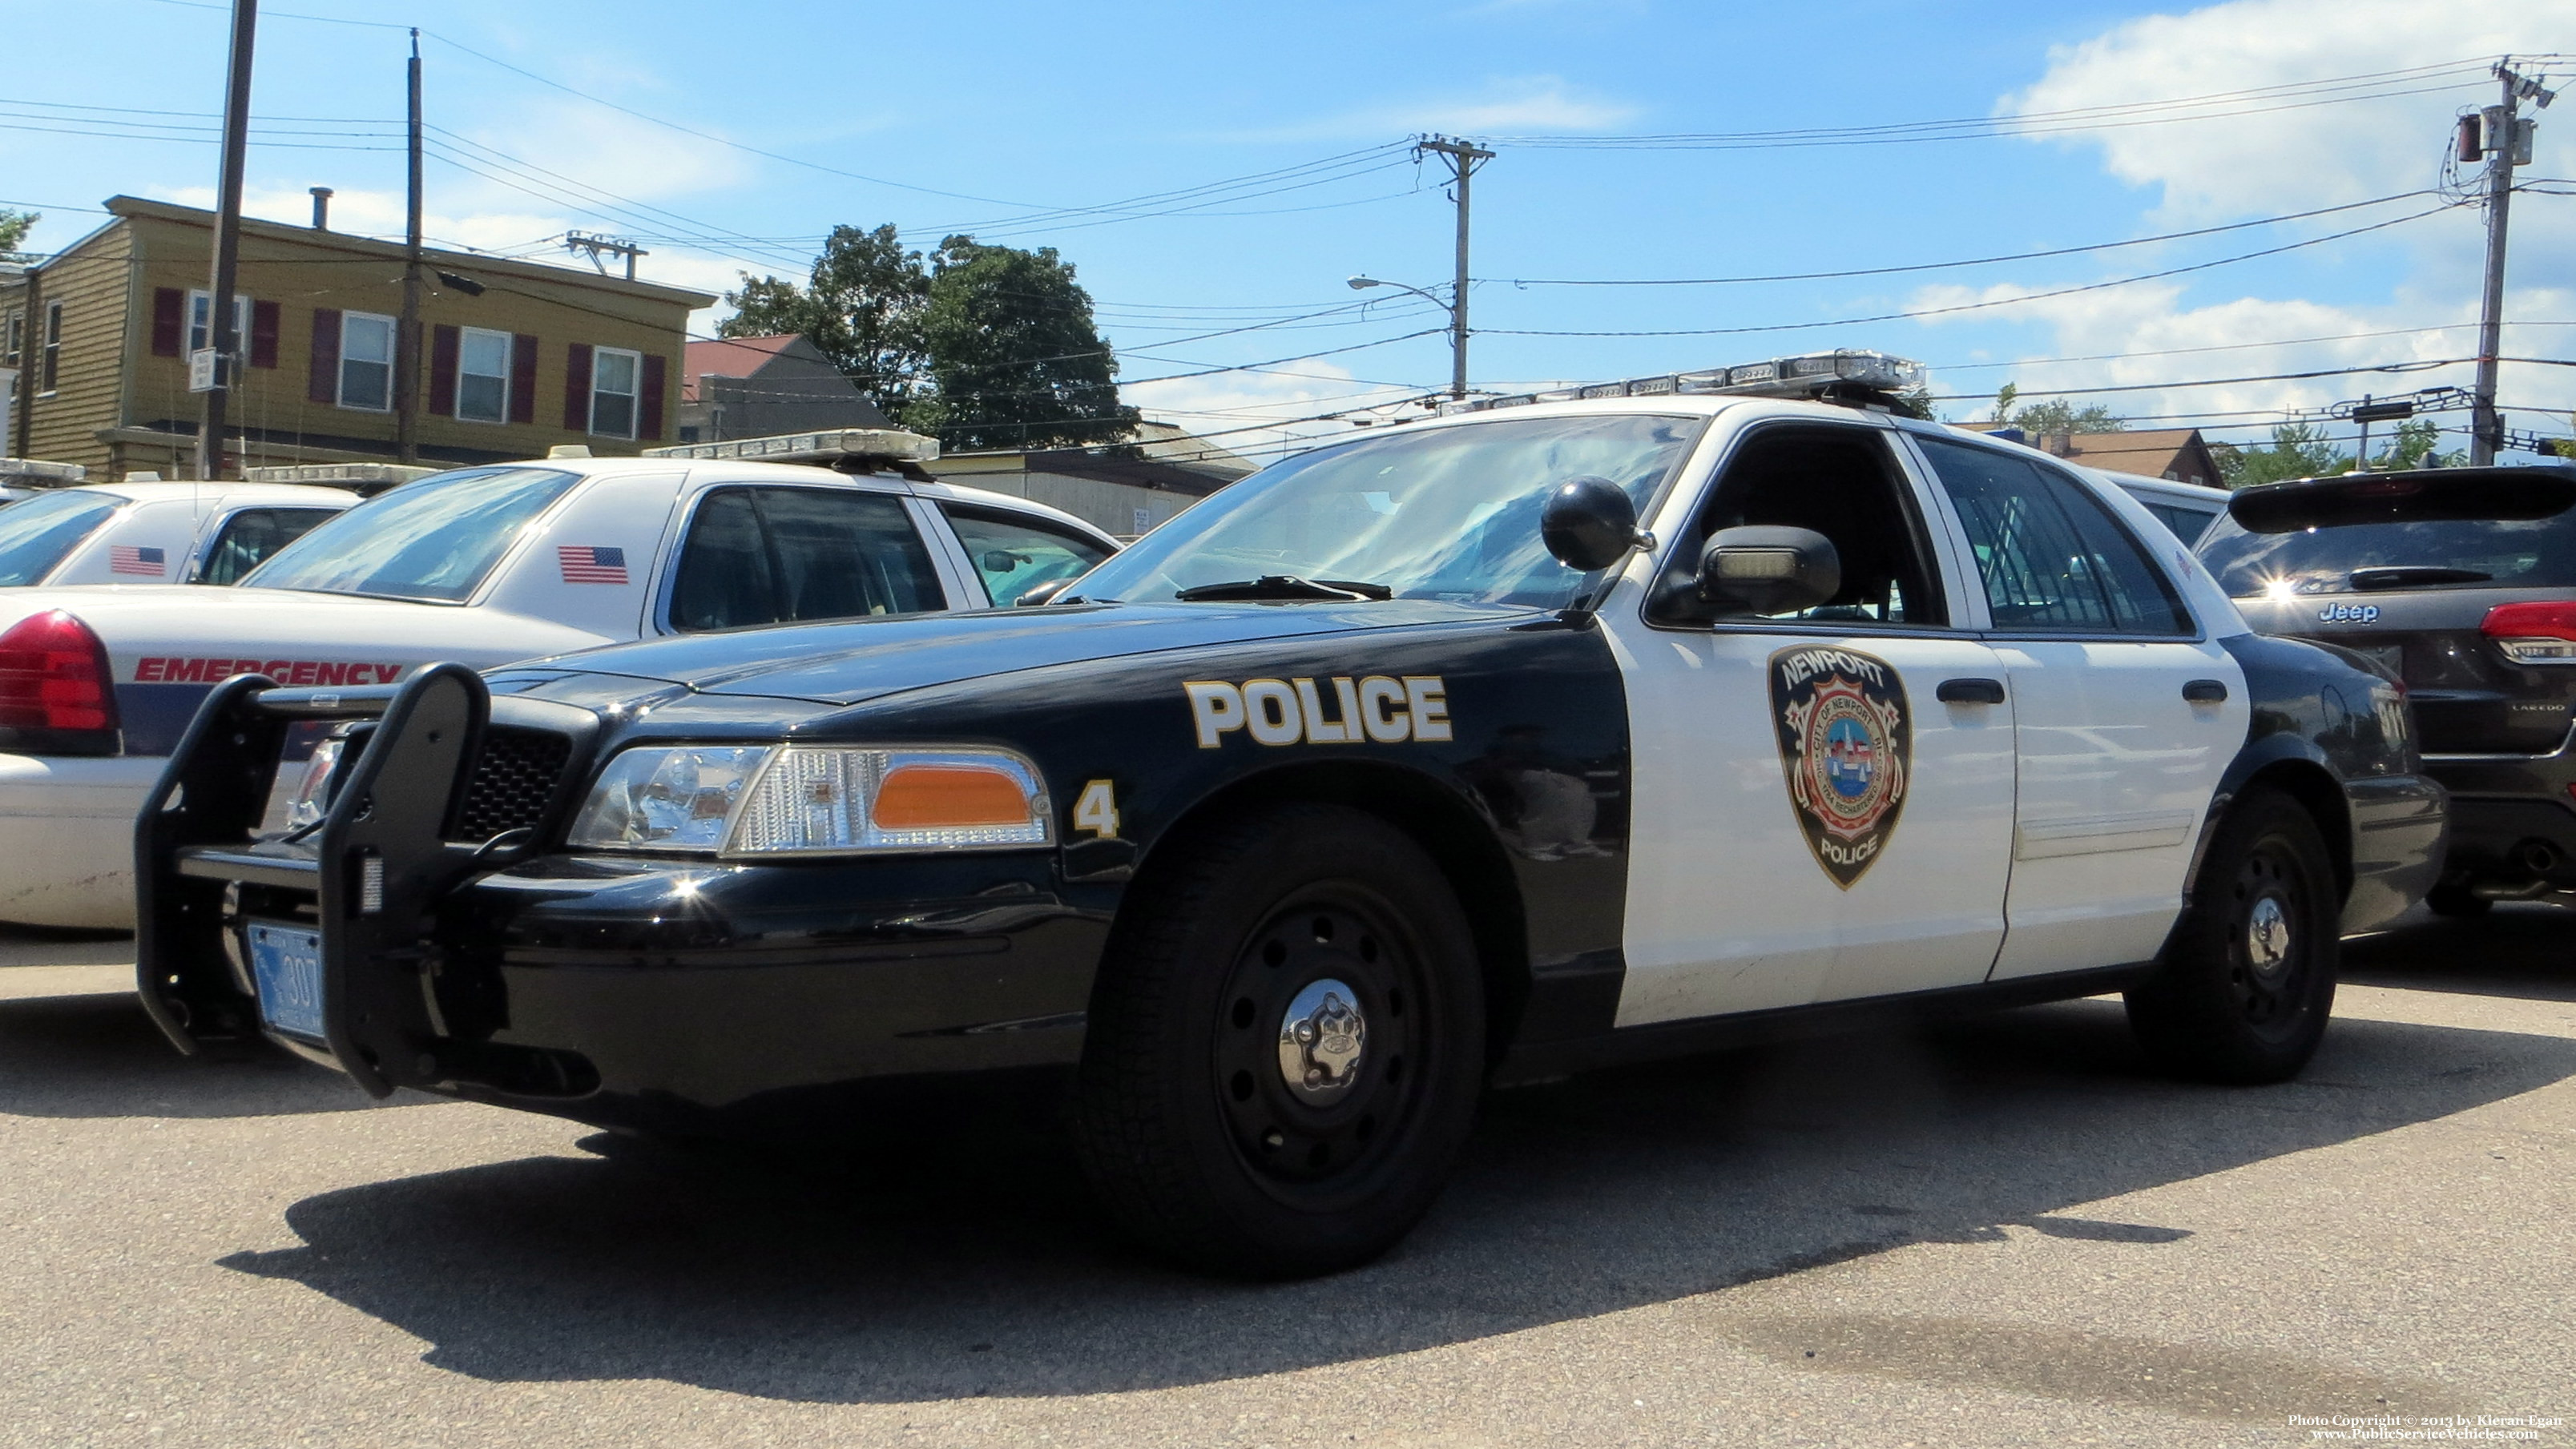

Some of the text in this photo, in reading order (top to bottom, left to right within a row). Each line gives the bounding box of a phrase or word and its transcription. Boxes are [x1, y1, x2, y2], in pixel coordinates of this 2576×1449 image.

[2319, 602, 2380, 624] Jeep
[134, 657, 403, 686] EMERGENCY
[1781, 649, 1885, 691] NEWPORT
[1183, 675, 1453, 749] POLICE
[1813, 698, 1883, 751] CITY OF NEWPORT RI
[2512, 704, 2566, 712] LAREDO
[1073, 779, 1120, 839] 4
[1820, 834, 1878, 864] POLICE
